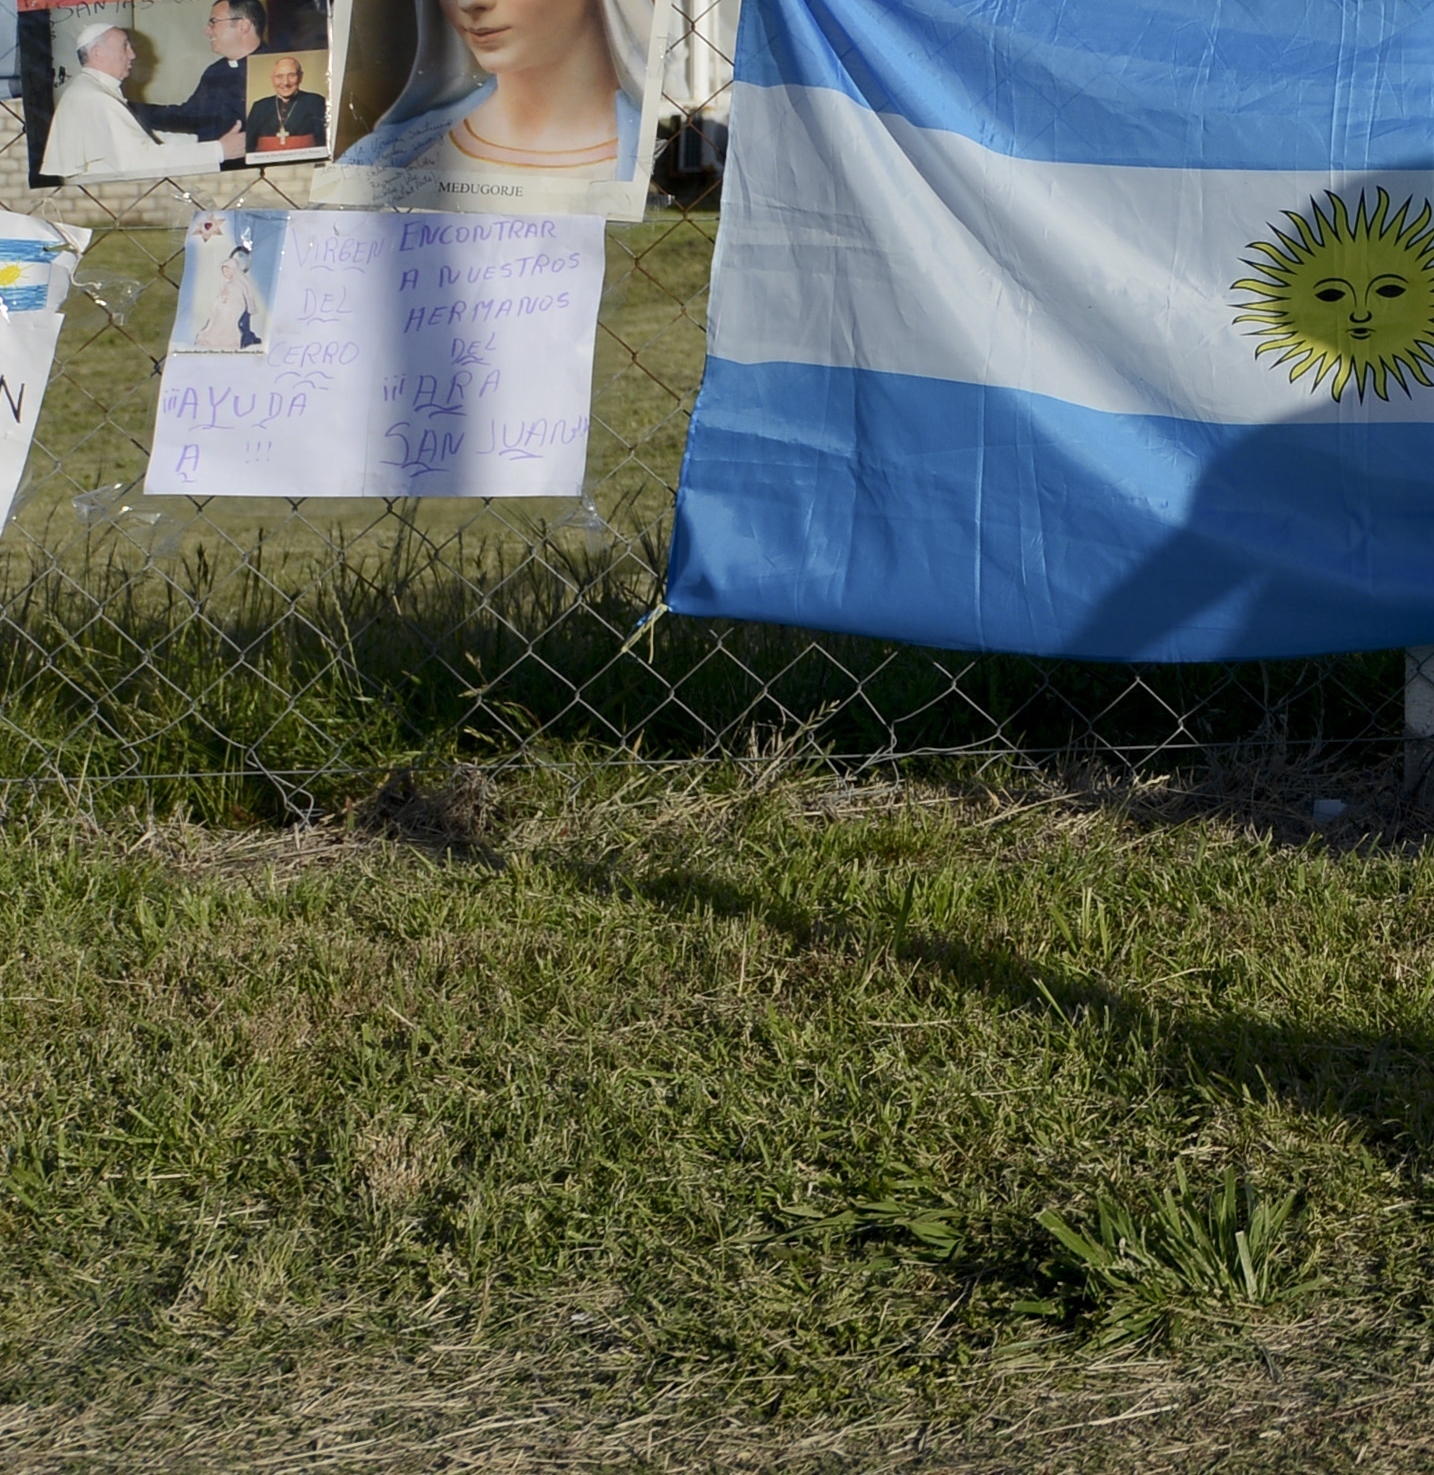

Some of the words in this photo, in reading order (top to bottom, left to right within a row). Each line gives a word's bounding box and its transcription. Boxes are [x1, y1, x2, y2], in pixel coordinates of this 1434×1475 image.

[291, 227, 385, 268] VIRGEN
[399, 219, 557, 252] ENCONTRAR
[399, 268, 419, 292] A
[438, 252, 580, 289] NUESTROS
[300, 286, 353, 322] DEL
[403, 291, 571, 334] HERMANOS
[266, 341, 360, 369] CERRO
[451, 332, 497, 362] DEL
[175, 442, 200, 474] A
[381, 421, 465, 467] SAN
